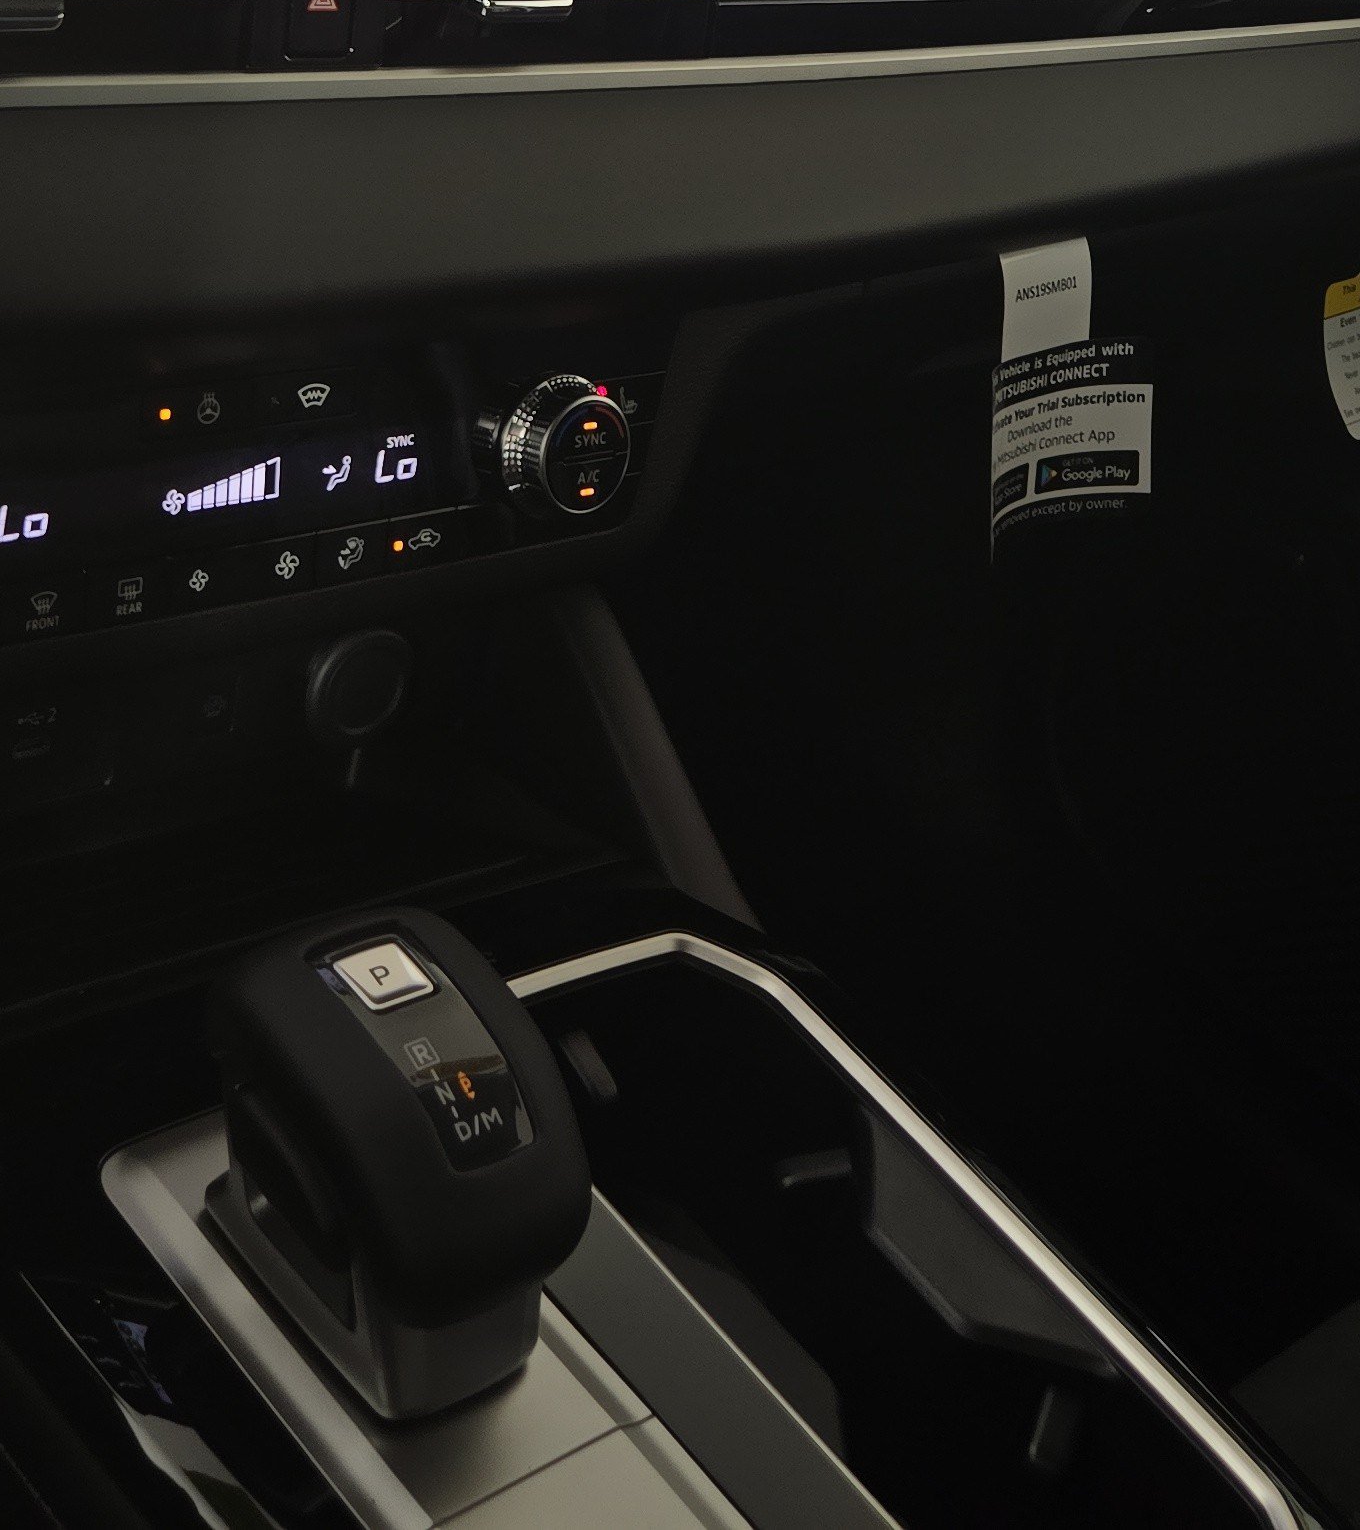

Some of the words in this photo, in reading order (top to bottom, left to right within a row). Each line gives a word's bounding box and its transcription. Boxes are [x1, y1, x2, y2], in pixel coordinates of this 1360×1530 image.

[999, 362, 1031, 381] Vehicle
[1034, 357, 1043, 369] is
[1046, 345, 1096, 367] Equipped
[1101, 343, 1134, 356] with
[995, 374, 1047, 404] MITSUBISHI
[1050, 363, 1110, 385] CONNECT
[1014, 405, 1035, 421] Your
[1038, 398, 1059, 414] Trial
[1061, 391, 1145, 408] Subscription
[1006, 418, 1052, 443] Download
[1054, 414, 1073, 428] the
[386, 434, 415, 449] SYNC
[574, 432, 607, 449] SYNC
[1039, 432, 1085, 450] Connect
[1088, 429, 1115, 444] App
[374, 449, 418, 484] Lo
[577, 469, 601, 484] A/C
[1062, 467, 1103, 482] Google
[1105, 465, 1131, 481] Play
[1031, 502, 1066, 517] except
[1068, 501, 1083, 512] by
[1086, 499, 1128, 510] owner.
[116, 601, 143, 616] REAR
[25, 615, 60, 632] FRONT
[369, 965, 389, 986] P
[412, 1043, 432, 1064] R
[434, 1081, 456, 1105] N
[454, 1106, 503, 1142] D/M
